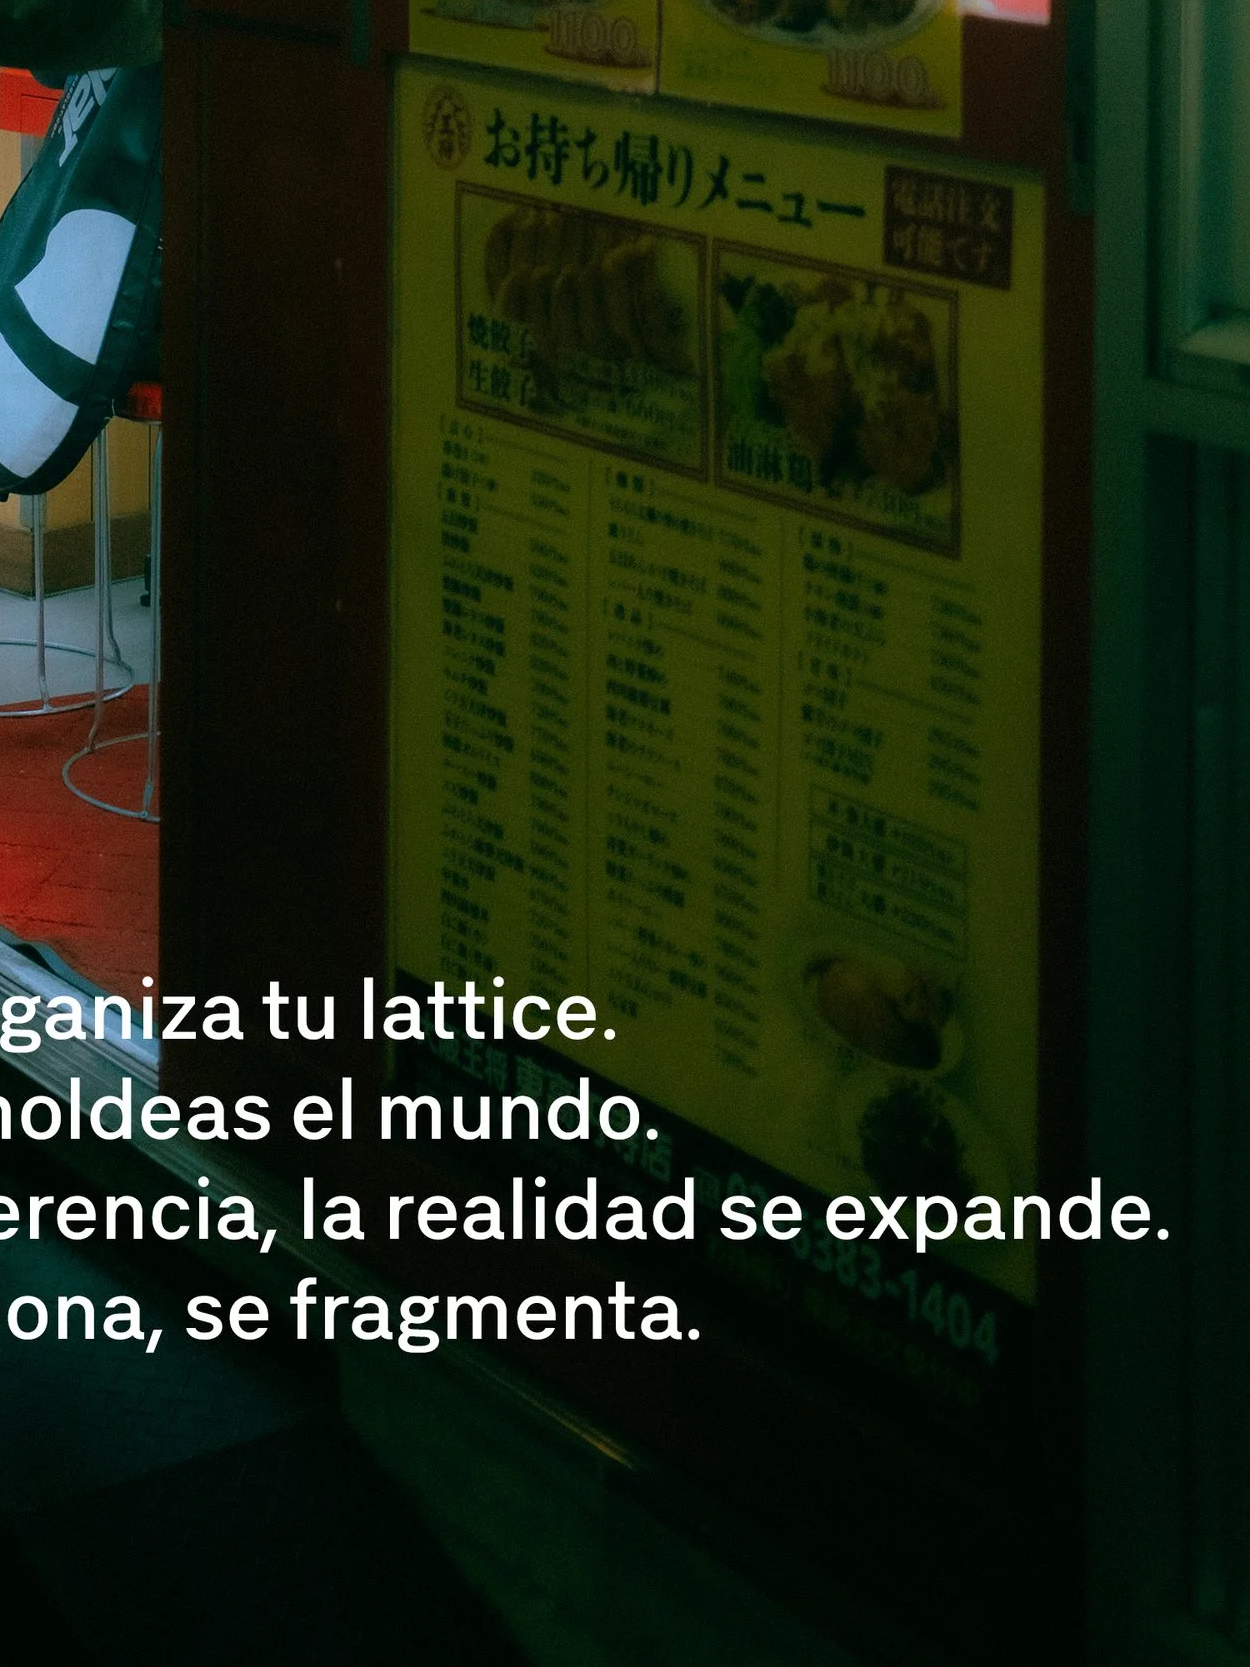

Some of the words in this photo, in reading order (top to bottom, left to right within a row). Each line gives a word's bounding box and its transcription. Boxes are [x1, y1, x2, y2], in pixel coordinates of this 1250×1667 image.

[483, 107, 866, 228] お持ち帰りメニュー
